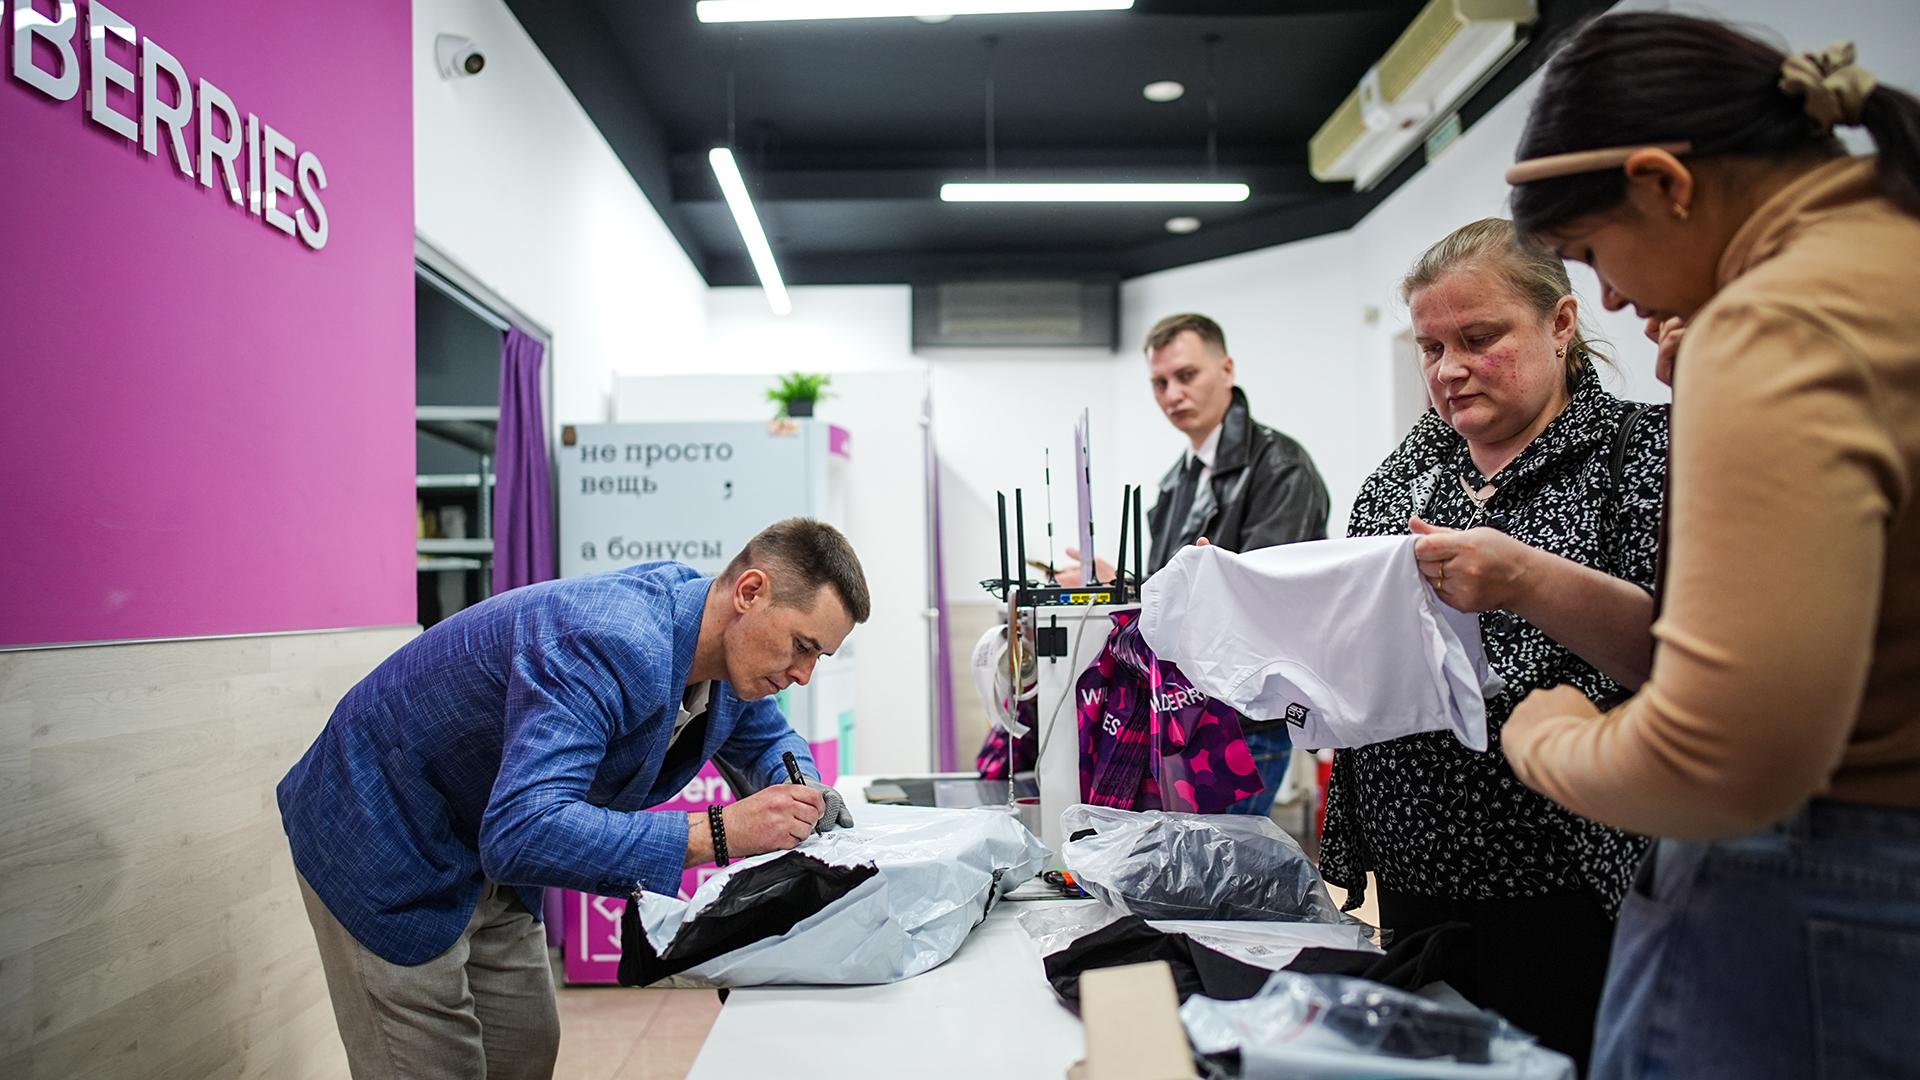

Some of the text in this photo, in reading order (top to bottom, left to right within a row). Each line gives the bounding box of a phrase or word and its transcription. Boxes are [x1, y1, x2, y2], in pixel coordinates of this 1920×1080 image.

[0, 0, 329, 250] BERRIES
[580, 442, 733, 469] не просто
[580, 474, 658, 499] вещь
[580, 536, 722, 561] а бонусы
